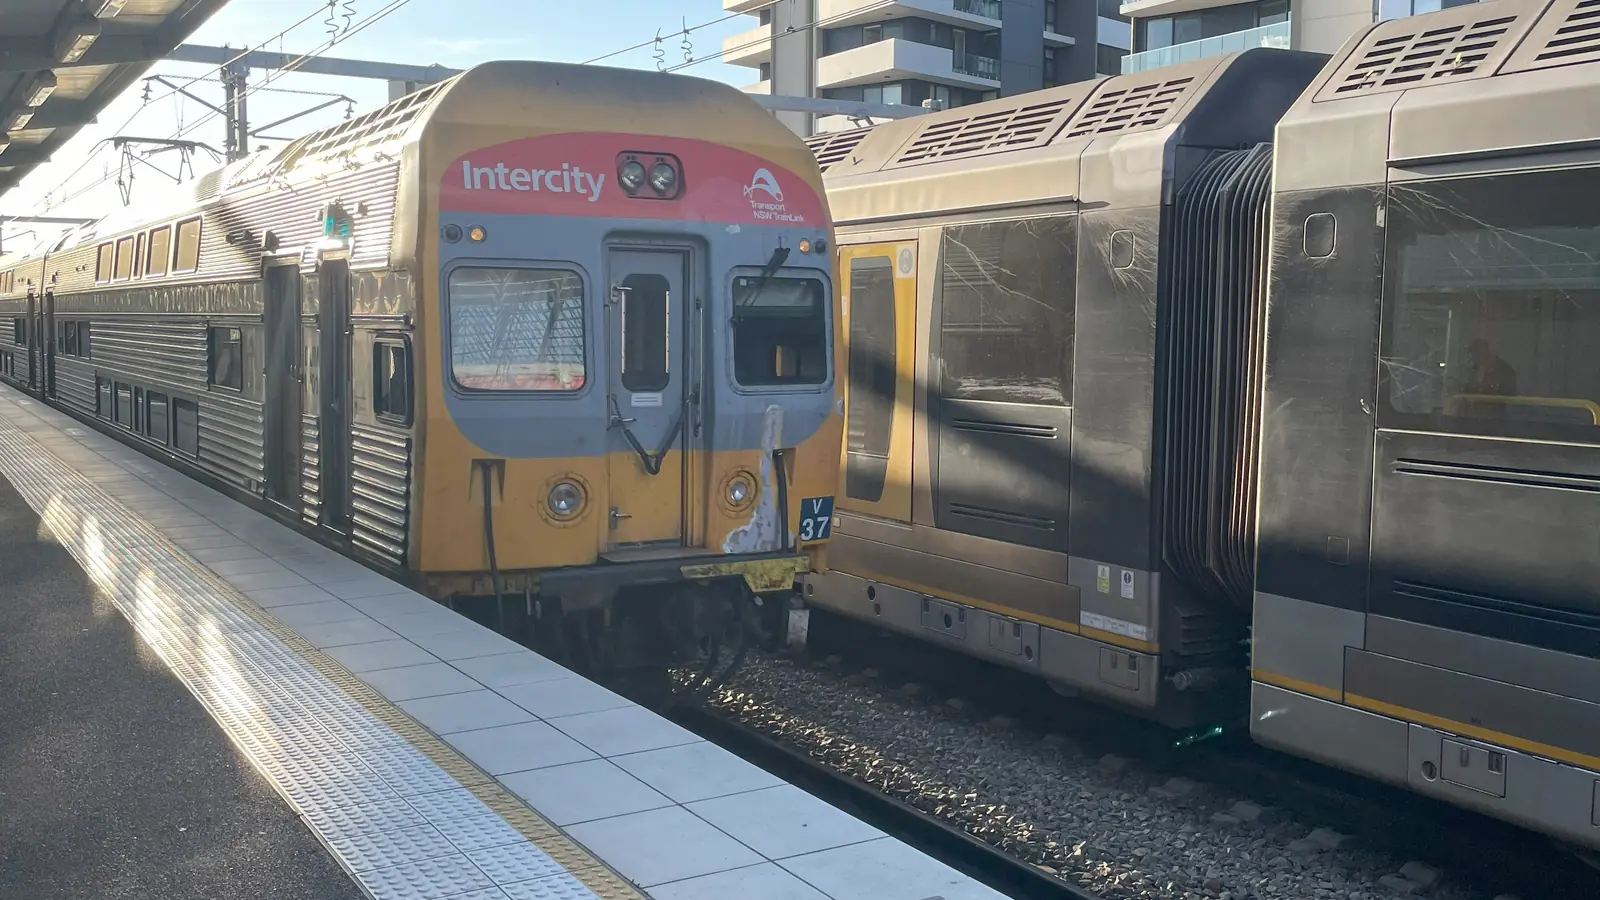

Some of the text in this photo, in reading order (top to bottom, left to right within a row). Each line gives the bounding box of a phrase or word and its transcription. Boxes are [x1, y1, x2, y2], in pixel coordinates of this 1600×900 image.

[462, 160, 606, 202] Intercity
[750, 200, 786, 212] Transport
[753, 210, 773, 220] NSW
[812, 498, 823, 515] V
[800, 516, 829, 541] 37
